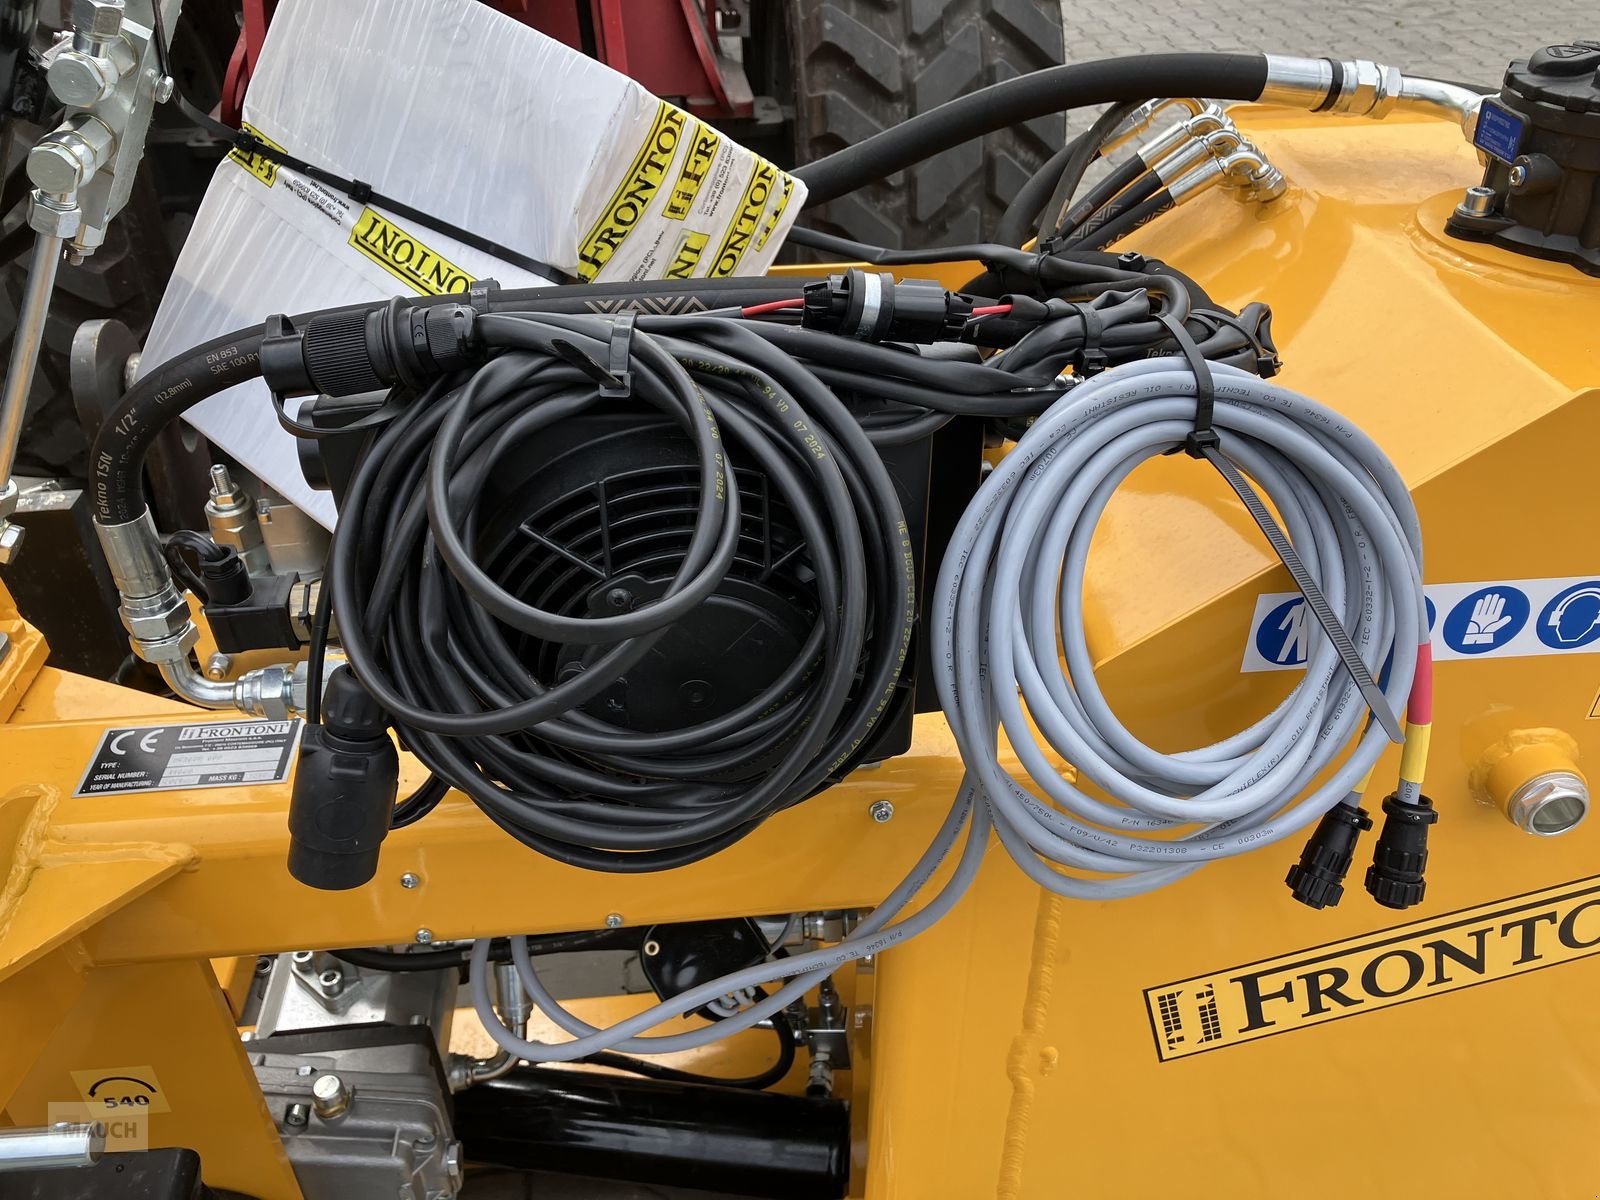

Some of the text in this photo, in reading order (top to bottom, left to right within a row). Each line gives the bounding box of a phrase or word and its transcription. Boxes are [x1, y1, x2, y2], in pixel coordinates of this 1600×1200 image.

[206, 347, 238, 365] EN 853
[210, 360, 229, 376] SAE
[229, 355, 247, 368] 100
[1143, 383, 1162, 394] OIL
[1083, 388, 1138, 418] RESISTANT
[763, 386, 777, 401] 94
[793, 419, 809, 433] 07
[803, 434, 828, 461] 2024
[1303, 407, 1331, 425] 16346
[1335, 423, 1354, 440] P/N
[99, 451, 113, 477] 1SN
[714, 452, 723, 469] 07
[1019, 450, 1035, 469] IEC
[715, 470, 725, 501] 2024
[99, 477, 112, 521] Tekno
[958, 549, 970, 570] IEC
[1363, 564, 1373, 623] 60332-1-2
[906, 608, 914, 624] 20
[897, 627, 912, 663] 22/20
[1361, 632, 1371, 646] IEC
[875, 697, 890, 713] 94
[199, 722, 289, 739] FRONTONI
[1320, 724, 1335, 741] IEC
[826, 751, 851, 775] 2024
[1121, 817, 1141, 827] P/N
[1211, 841, 1226, 851] CE
[1236, 828, 1275, 846] 00303m
[103, 1094, 150, 1109] 540
